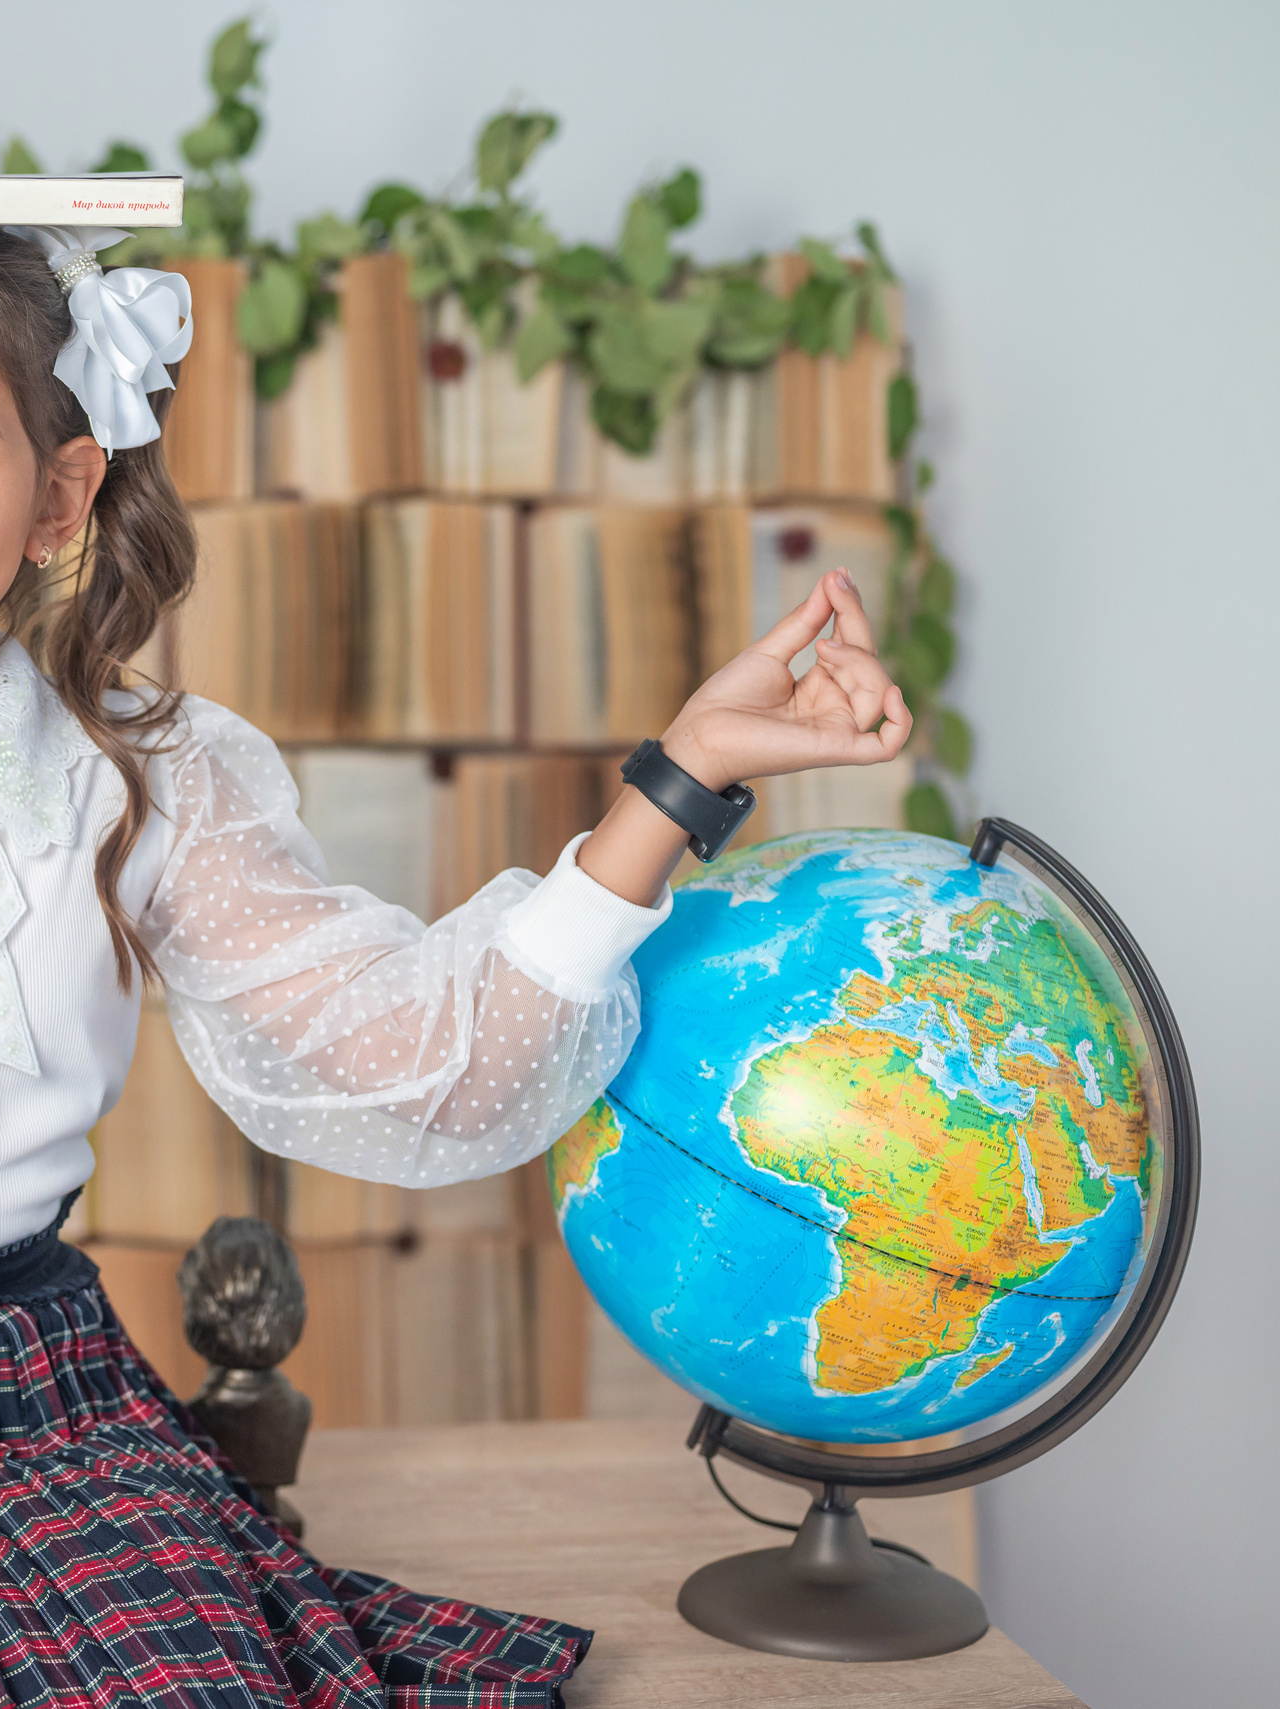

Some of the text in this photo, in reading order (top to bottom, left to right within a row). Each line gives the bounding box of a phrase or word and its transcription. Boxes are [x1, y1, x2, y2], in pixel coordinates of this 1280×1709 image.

[72, 200, 170, 211] Мир дикой природы
